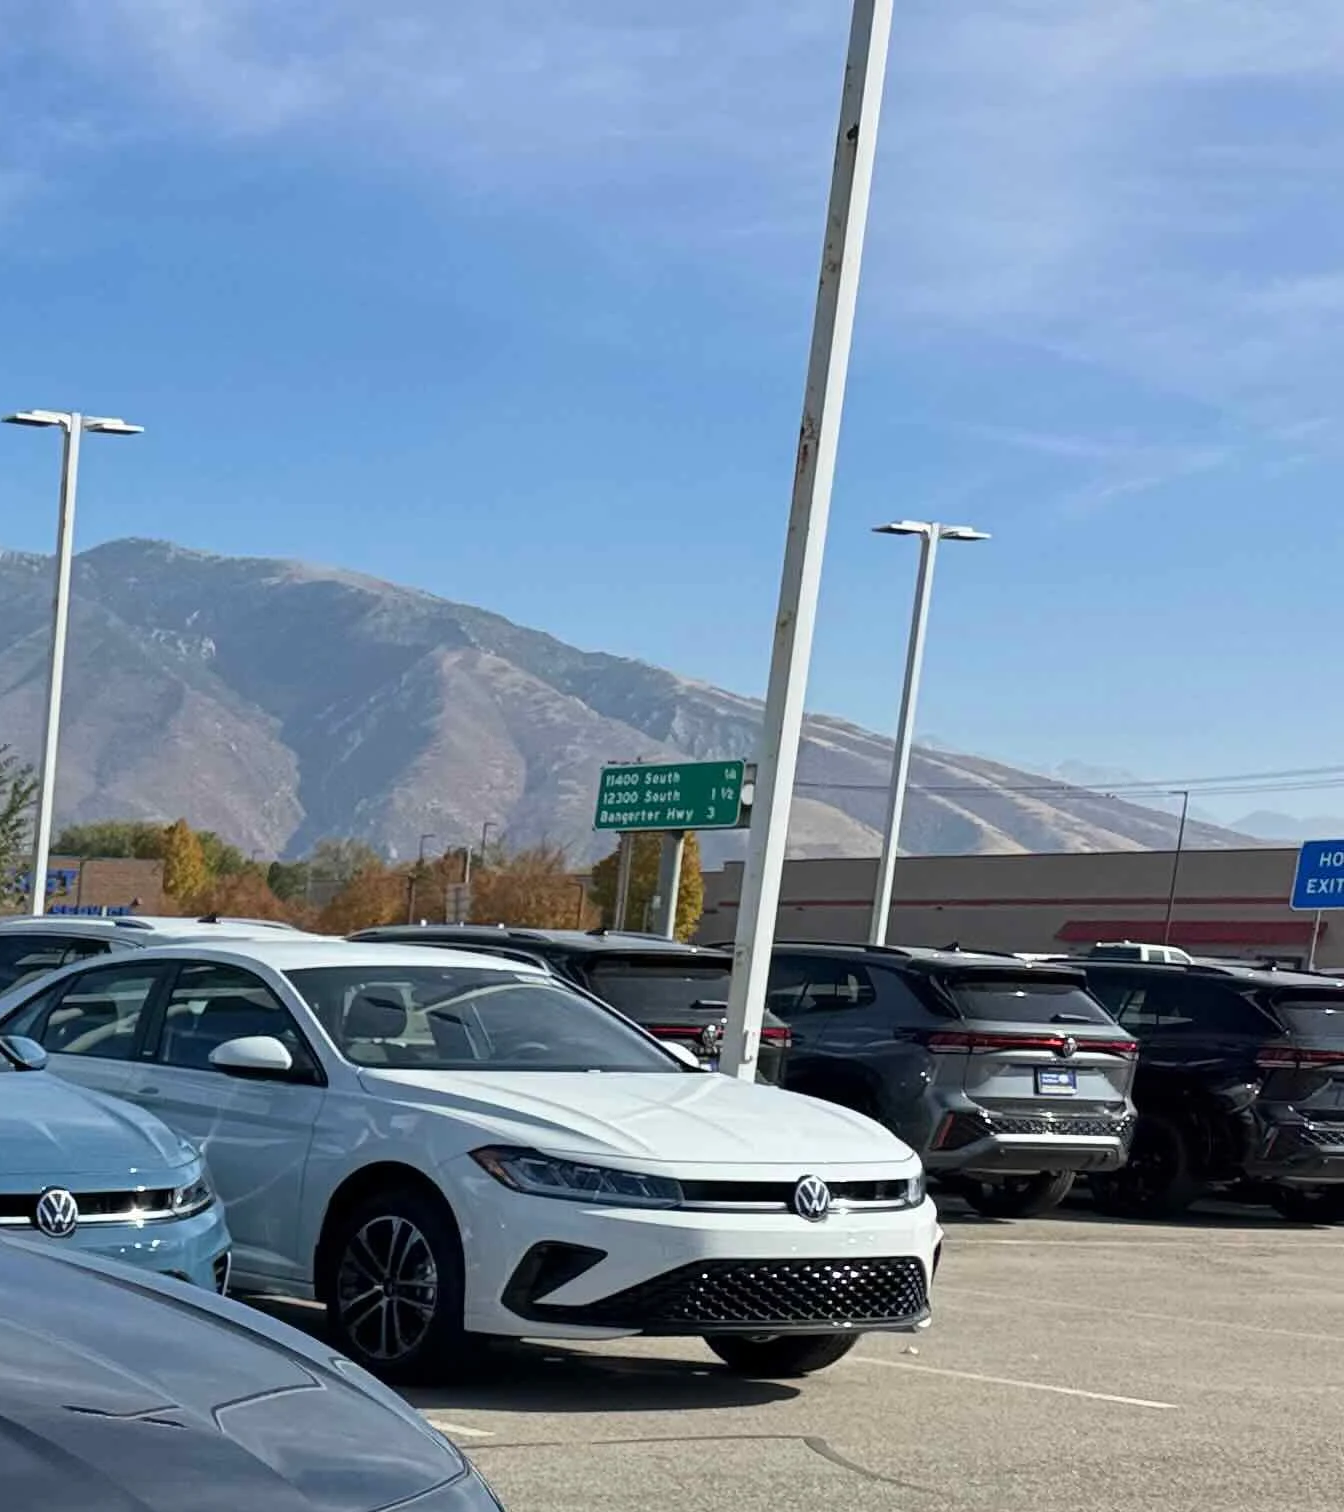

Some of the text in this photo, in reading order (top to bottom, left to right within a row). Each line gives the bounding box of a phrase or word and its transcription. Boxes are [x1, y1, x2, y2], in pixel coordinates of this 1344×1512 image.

[606, 773, 640, 787] 11400
[644, 771, 681, 786] South
[603, 791, 639, 805] 12300
[644, 789, 681, 804] South
[600, 806, 716, 825] Bangerter Hwy 3
